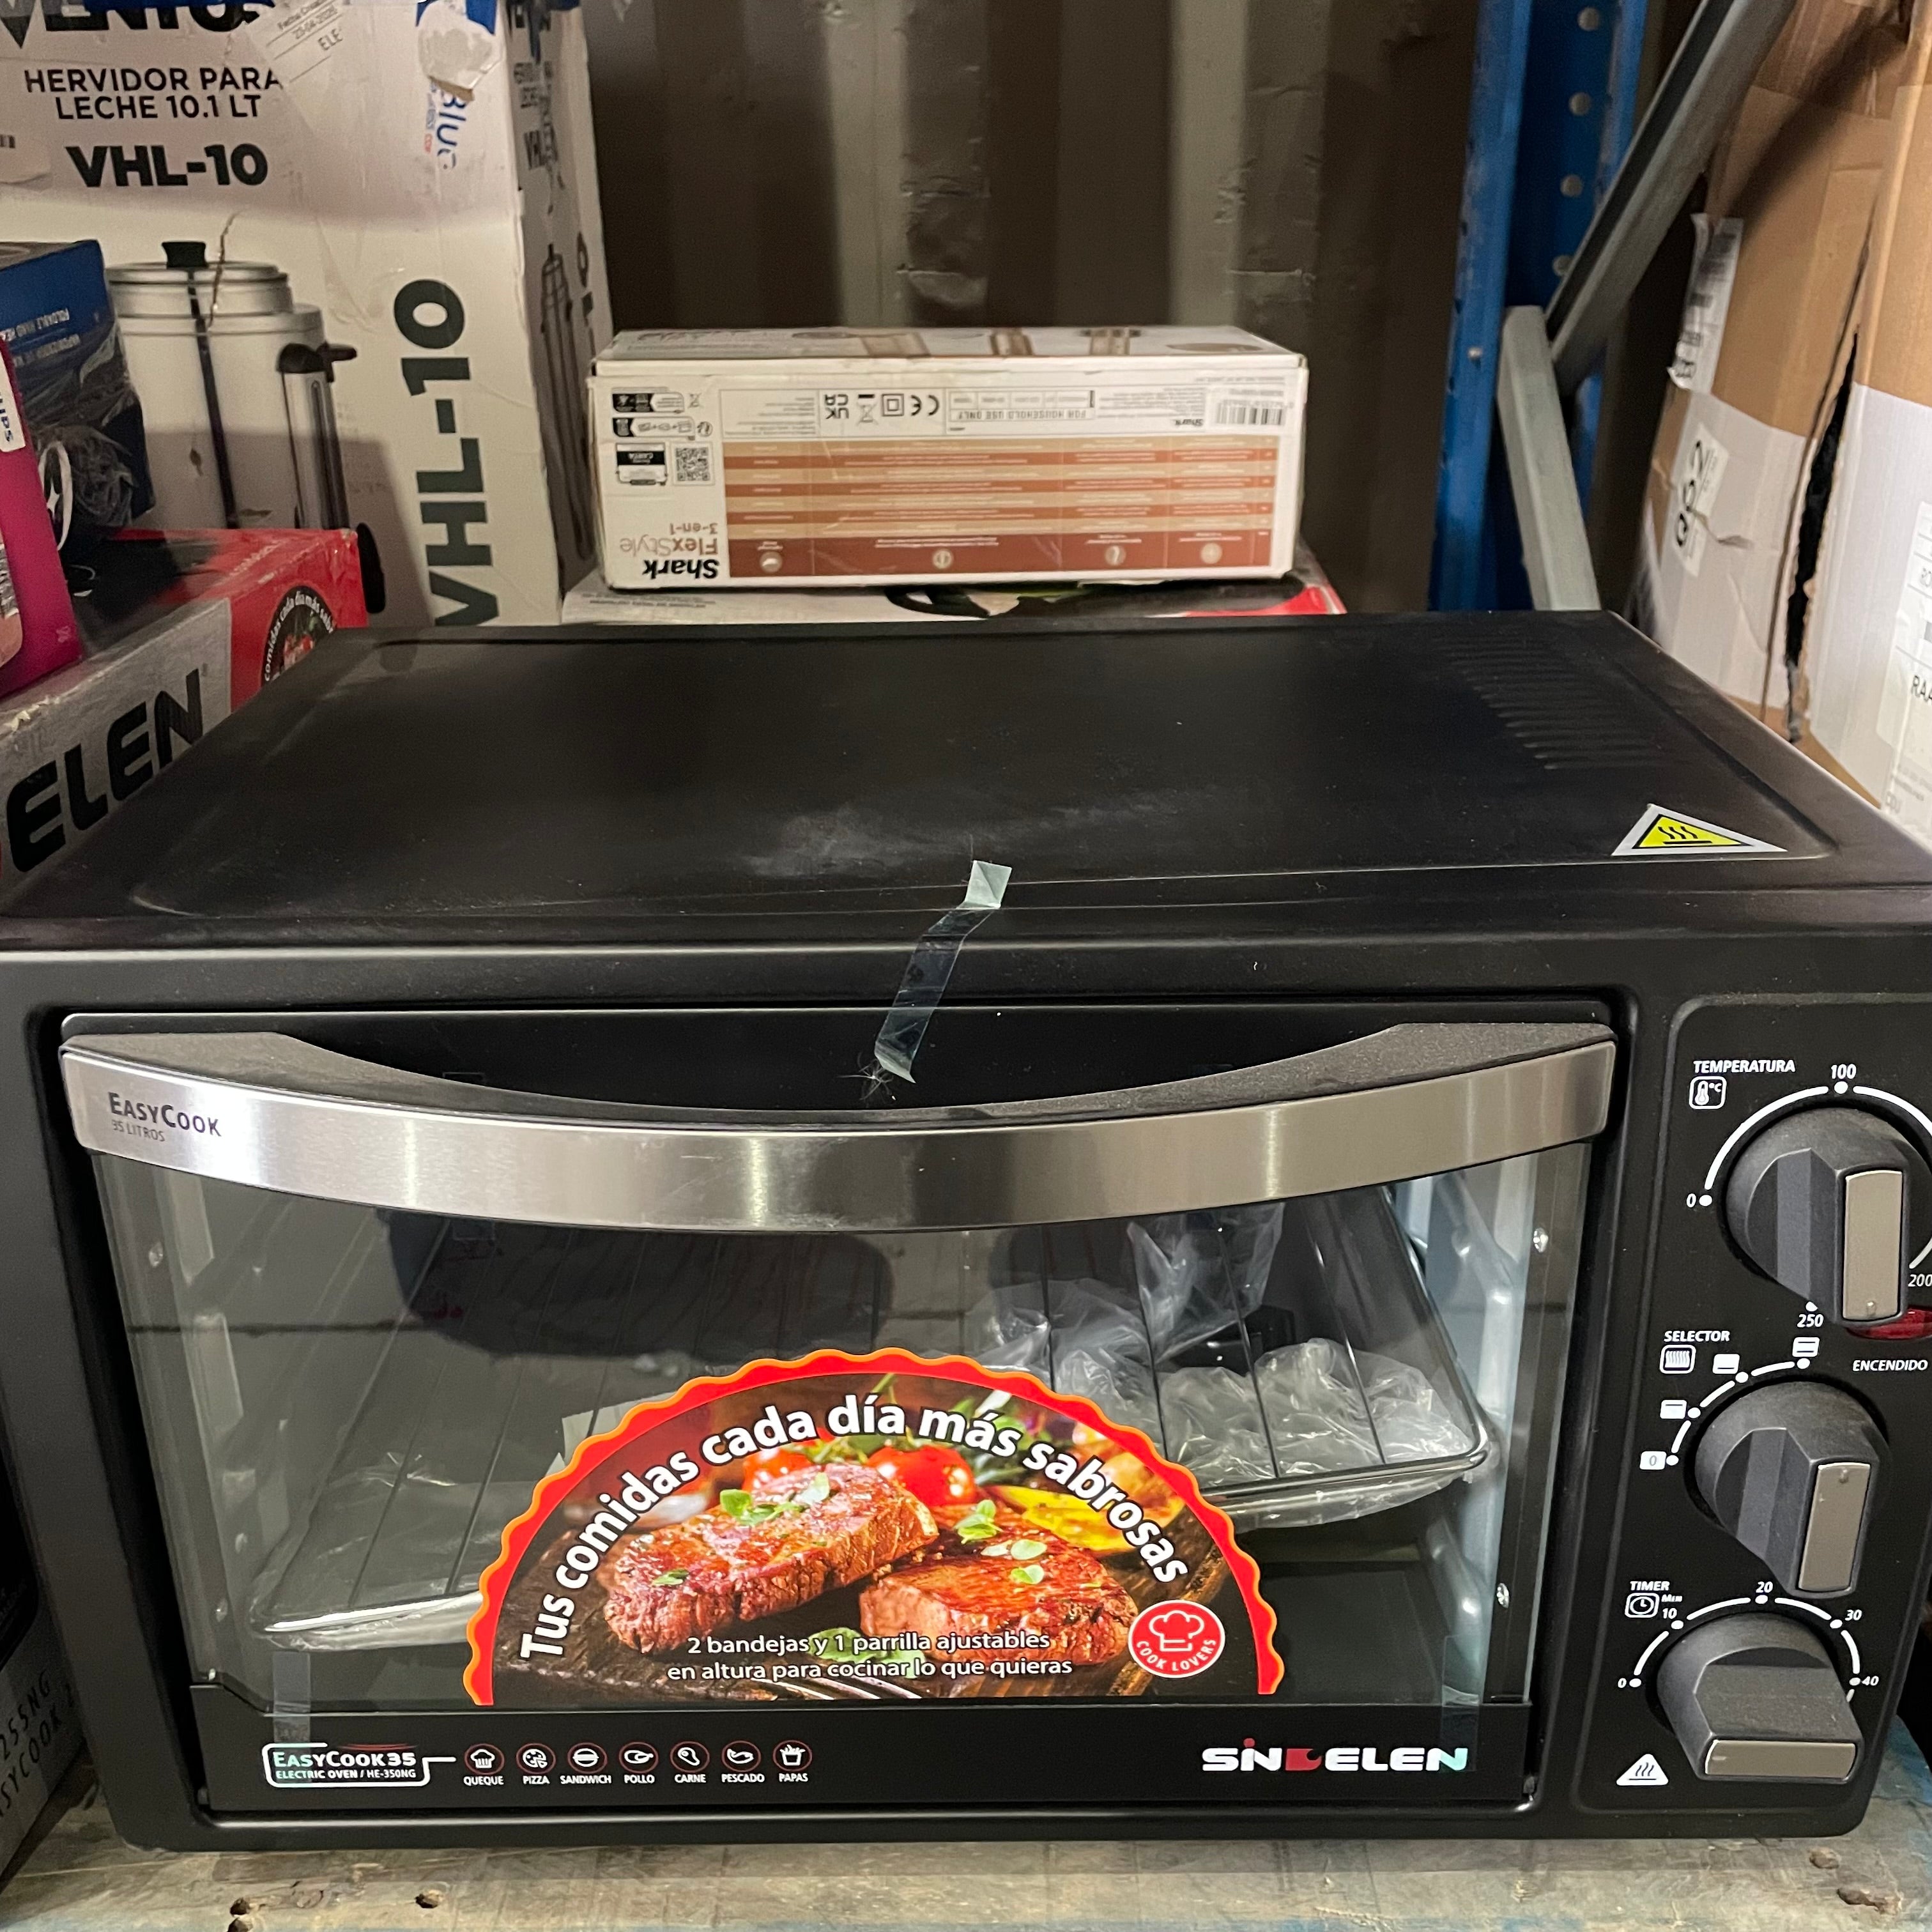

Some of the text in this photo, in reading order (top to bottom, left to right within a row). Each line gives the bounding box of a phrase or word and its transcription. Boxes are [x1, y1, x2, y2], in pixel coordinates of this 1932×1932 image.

[24, 66, 284, 93] HERVIDOR PARA
[55, 95, 261, 119] LECHE 10.1 LT
[65, 143, 268, 187] VHL-10
[394, 279, 500, 626] VHL-10
[669, 523, 718, 535] 3-en-1
[620, 534, 718, 557] FlexStyle
[642, 559, 719, 579] Shark
[1693, 1059, 1796, 1073] TEMPERATURA
[1830, 1063, 1857, 1080] 100
[111, 1119, 165, 1142] 35 LITROS
[1686, 1193, 1696, 1208] 0
[1908, 1273, 1932, 1287] 200
[1797, 1314, 1824, 1328] 250
[1664, 1331, 1730, 1342] SELECTOR
[1852, 1360, 1929, 1372] ENCENDIDO
[521, 1395, 1188, 1657] Tus comidas cada día más sabrosas
[1630, 1581, 1670, 1591] TIMER
[1756, 1581, 1774, 1593] 20
[1662, 1608, 1678, 1619] 10
[1845, 1609, 1862, 1621] 30
[687, 1631, 1050, 1656] 2 bandejas y 1 parrilla ajustables
[1137, 1639, 1216, 1671] COOK LOVERS
[668, 1659, 1072, 1682] en altura para cocinar lo que quieras
[1617, 1678, 1627, 1689] 0
[1862, 1675, 1879, 1687] 40
[276, 1770, 326, 1779] ELECTRIC
[328, 1770, 358, 1779] OVEN
[523, 1775, 550, 1784] PIZZA
[560, 1775, 612, 1784] SANDWICH
[624, 1775, 655, 1784] POLLO
[674, 1774, 707, 1784] CARNE
[721, 1774, 765, 1783] PESCADO
[779, 1773, 808, 1782] PAPAS
[463, 1776, 504, 1786] QUEQUE
